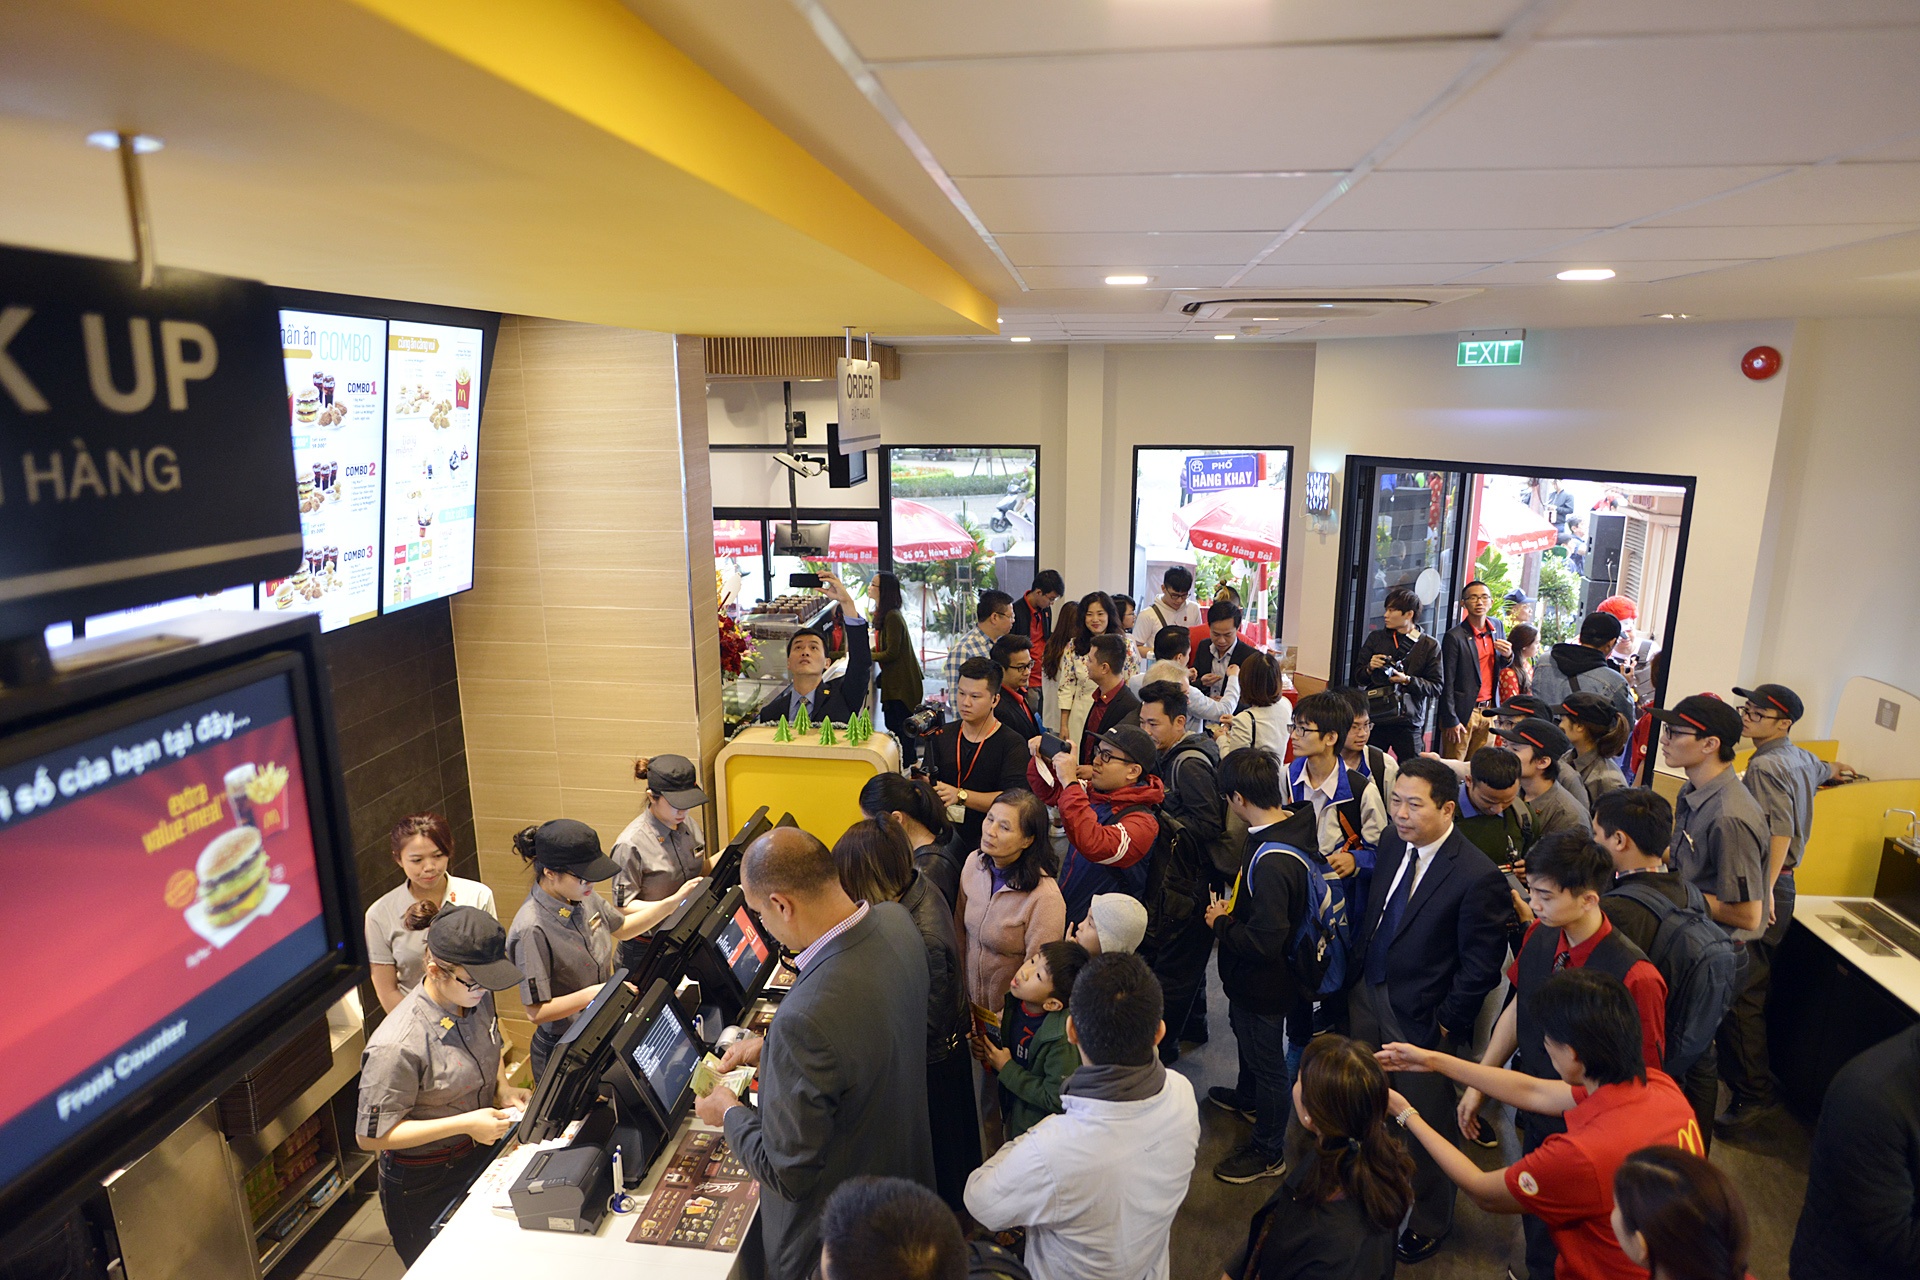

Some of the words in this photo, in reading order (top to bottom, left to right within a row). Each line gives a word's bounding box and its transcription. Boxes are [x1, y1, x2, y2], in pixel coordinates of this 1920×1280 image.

[303, 326, 316, 346] ăn
[319, 331, 371, 362] COMBO
[1464, 341, 1515, 364] EXIT
[80, 312, 219, 415] UP
[347, 382, 370, 393] COMBO
[371, 381, 377, 395] 1
[846, 373, 874, 399] ORDER
[22, 436, 182, 504] HÀNG
[345, 465, 368, 477] COMBO
[369, 462, 376, 476] 2
[1211, 458, 1233, 470] PHỐ
[1192, 471, 1222, 488] HÀNG
[1224, 471, 1252, 487] KHAY
[343, 549, 366, 562] COMBO
[366, 545, 373, 558] 3
[718, 545, 741, 555] Hàng
[743, 543, 758, 553] Bài
[839, 551, 858, 561] Hàng
[859, 550, 872, 559] Bài
[902, 548, 913, 559] Số
[928, 548, 949, 558] Hàng
[949, 545, 963, 555] Bài
[1202, 538, 1215, 548] Số
[1215, 542, 1229, 553] 02,
[1231, 545, 1256, 559] Hàng
[1256, 550, 1273, 561] Bài
[14, 764, 57, 814] số
[58, 756, 111, 797] của
[111, 738, 162, 776] bạn
[162, 720, 194, 759] tại
[167, 783, 209, 818] extra
[141, 819, 188, 855] value
[185, 794, 224, 833] meal
[56, 1066, 117, 1121] Front
[114, 1018, 188, 1080] Counter
